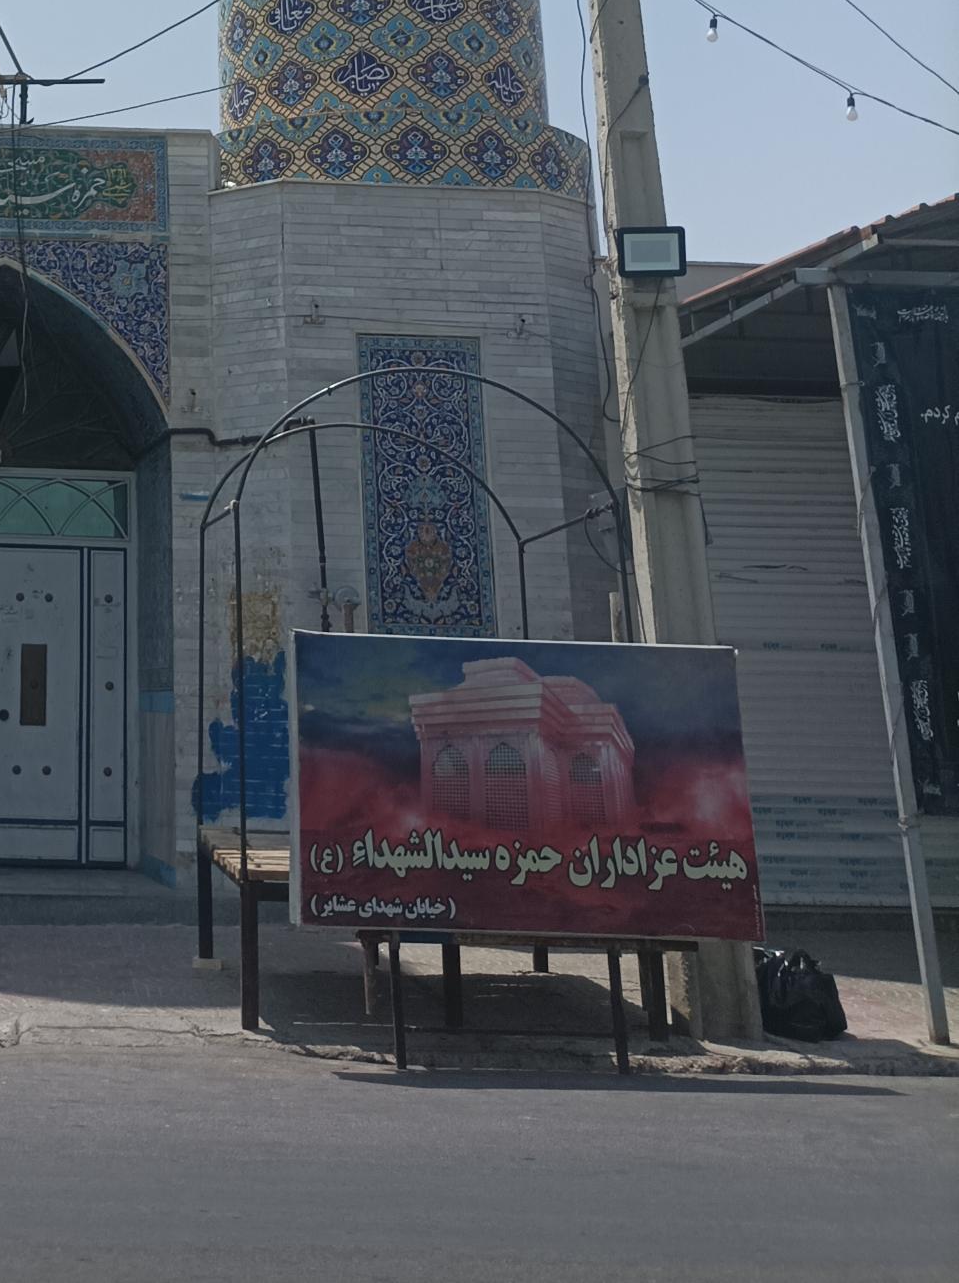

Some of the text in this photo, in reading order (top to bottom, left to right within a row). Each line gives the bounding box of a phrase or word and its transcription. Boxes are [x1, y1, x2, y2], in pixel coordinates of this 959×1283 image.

[309, 843, 345, 875] (ع)
[494, 838, 563, 886] حمزه
[568, 834, 678, 891] عزاداران
[682, 840, 749, 890] هیئت
[357, 895, 404, 919] شهدای
